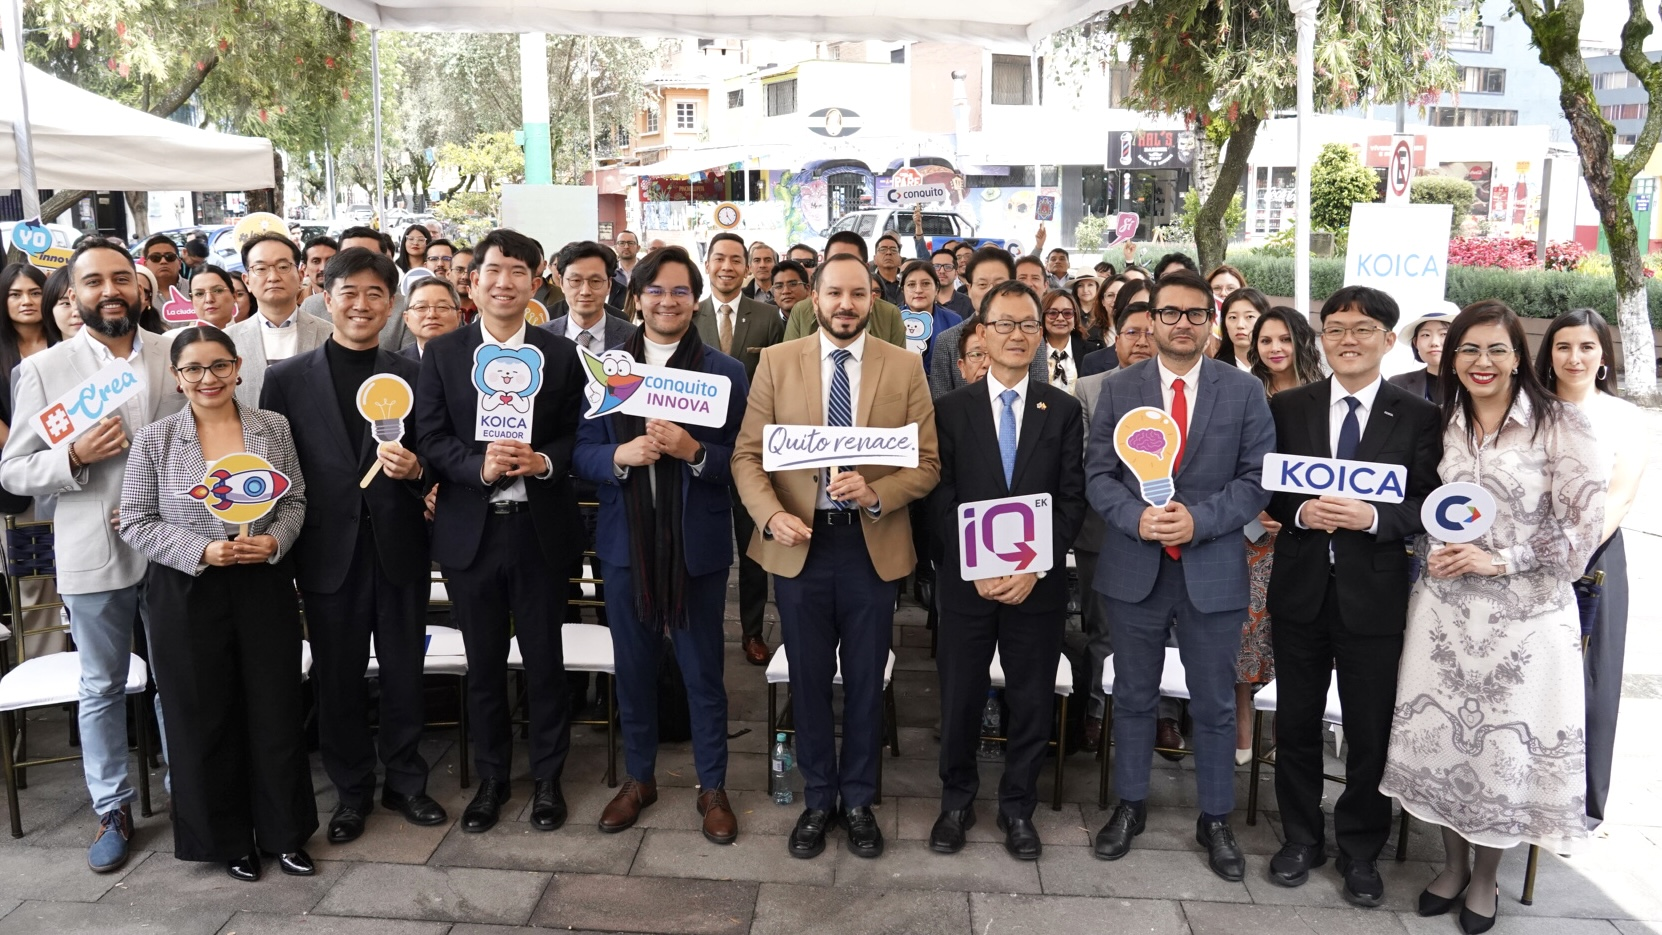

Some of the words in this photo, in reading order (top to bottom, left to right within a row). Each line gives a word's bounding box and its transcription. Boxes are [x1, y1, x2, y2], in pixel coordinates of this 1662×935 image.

[19, 230, 46, 247] YO
[1357, 253, 1439, 277] KOICA
[647, 392, 710, 413] INNOVA
[481, 415, 527, 429] KOICA
[483, 430, 524, 439] ECUADOR
[768, 427, 832, 455] Quito
[833, 436, 915, 452] renace.
[1281, 460, 1404, 498] KOICA
[1035, 498, 1048, 508] EK
